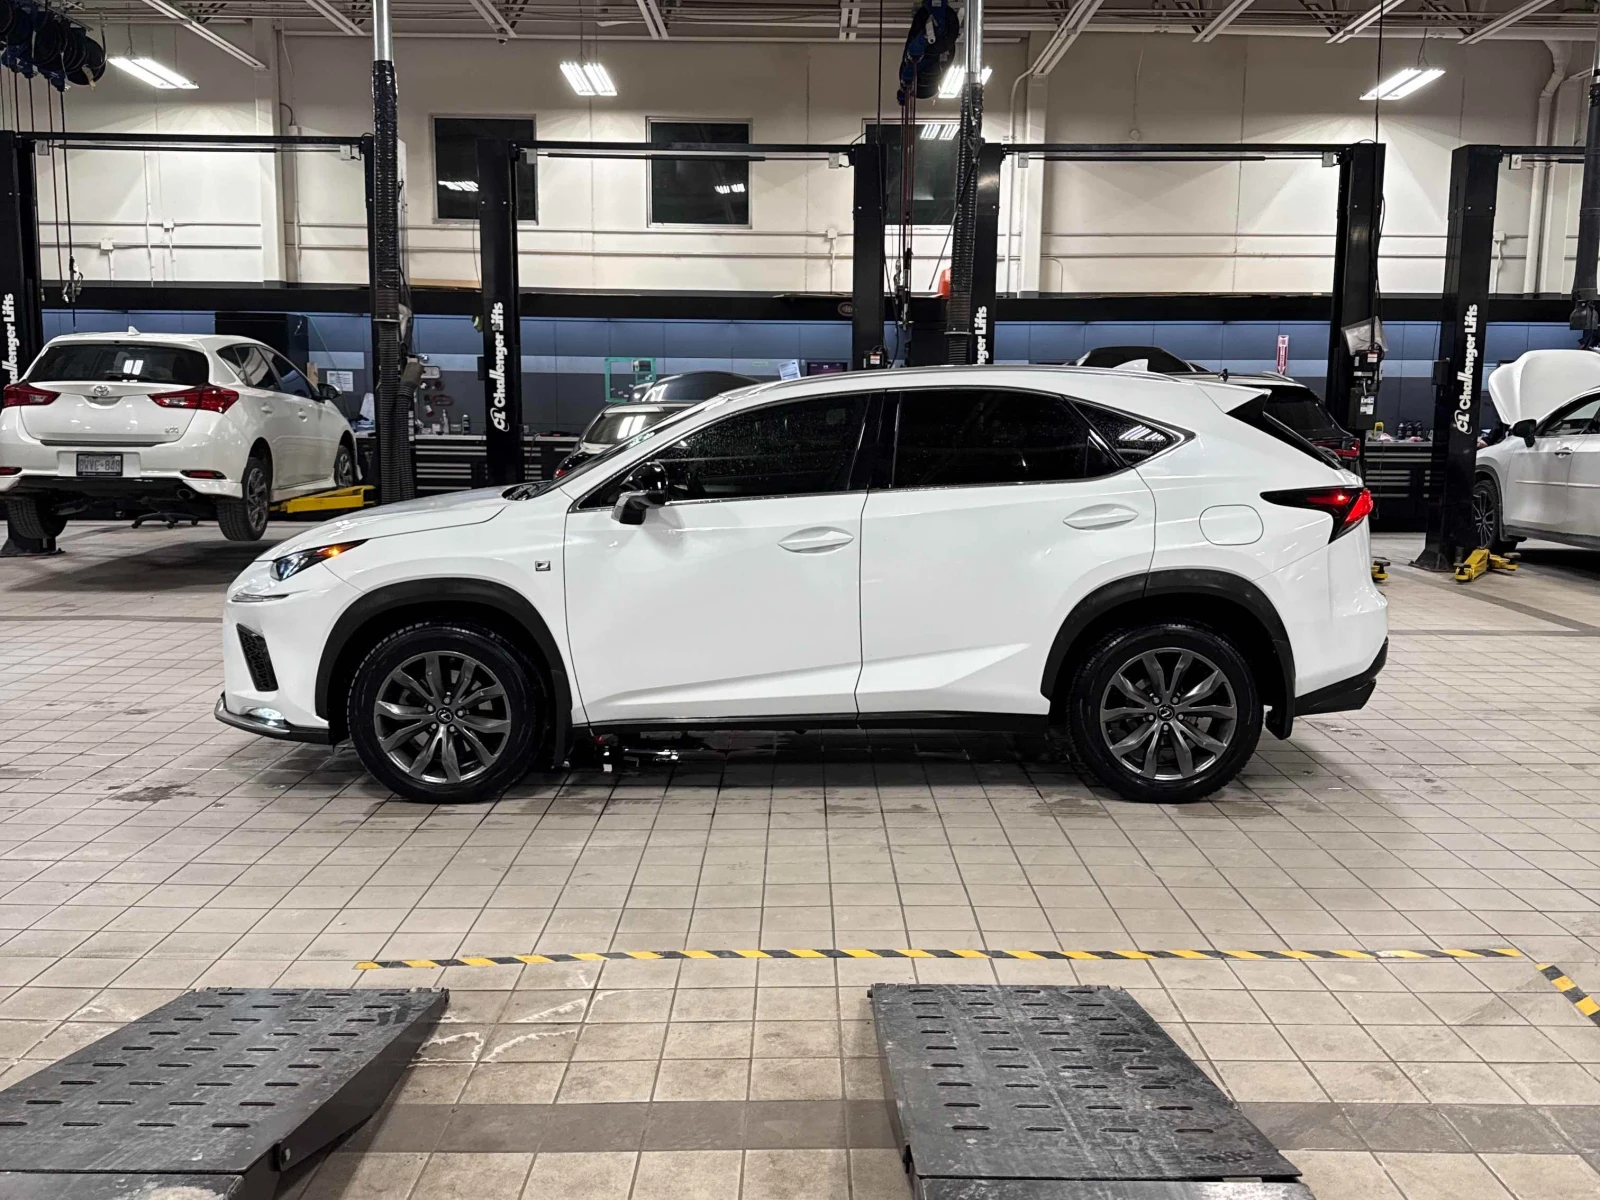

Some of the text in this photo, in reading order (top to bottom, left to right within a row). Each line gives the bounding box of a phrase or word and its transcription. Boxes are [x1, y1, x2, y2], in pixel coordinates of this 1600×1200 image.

[2, 293, 20, 384] allenger Lifts
[491, 302, 504, 331] Lifts
[974, 305, 987, 335] Lifts
[1464, 304, 1478, 333] Lifts
[489, 332, 508, 407] Challenger
[1457, 334, 1478, 410] Challenger
